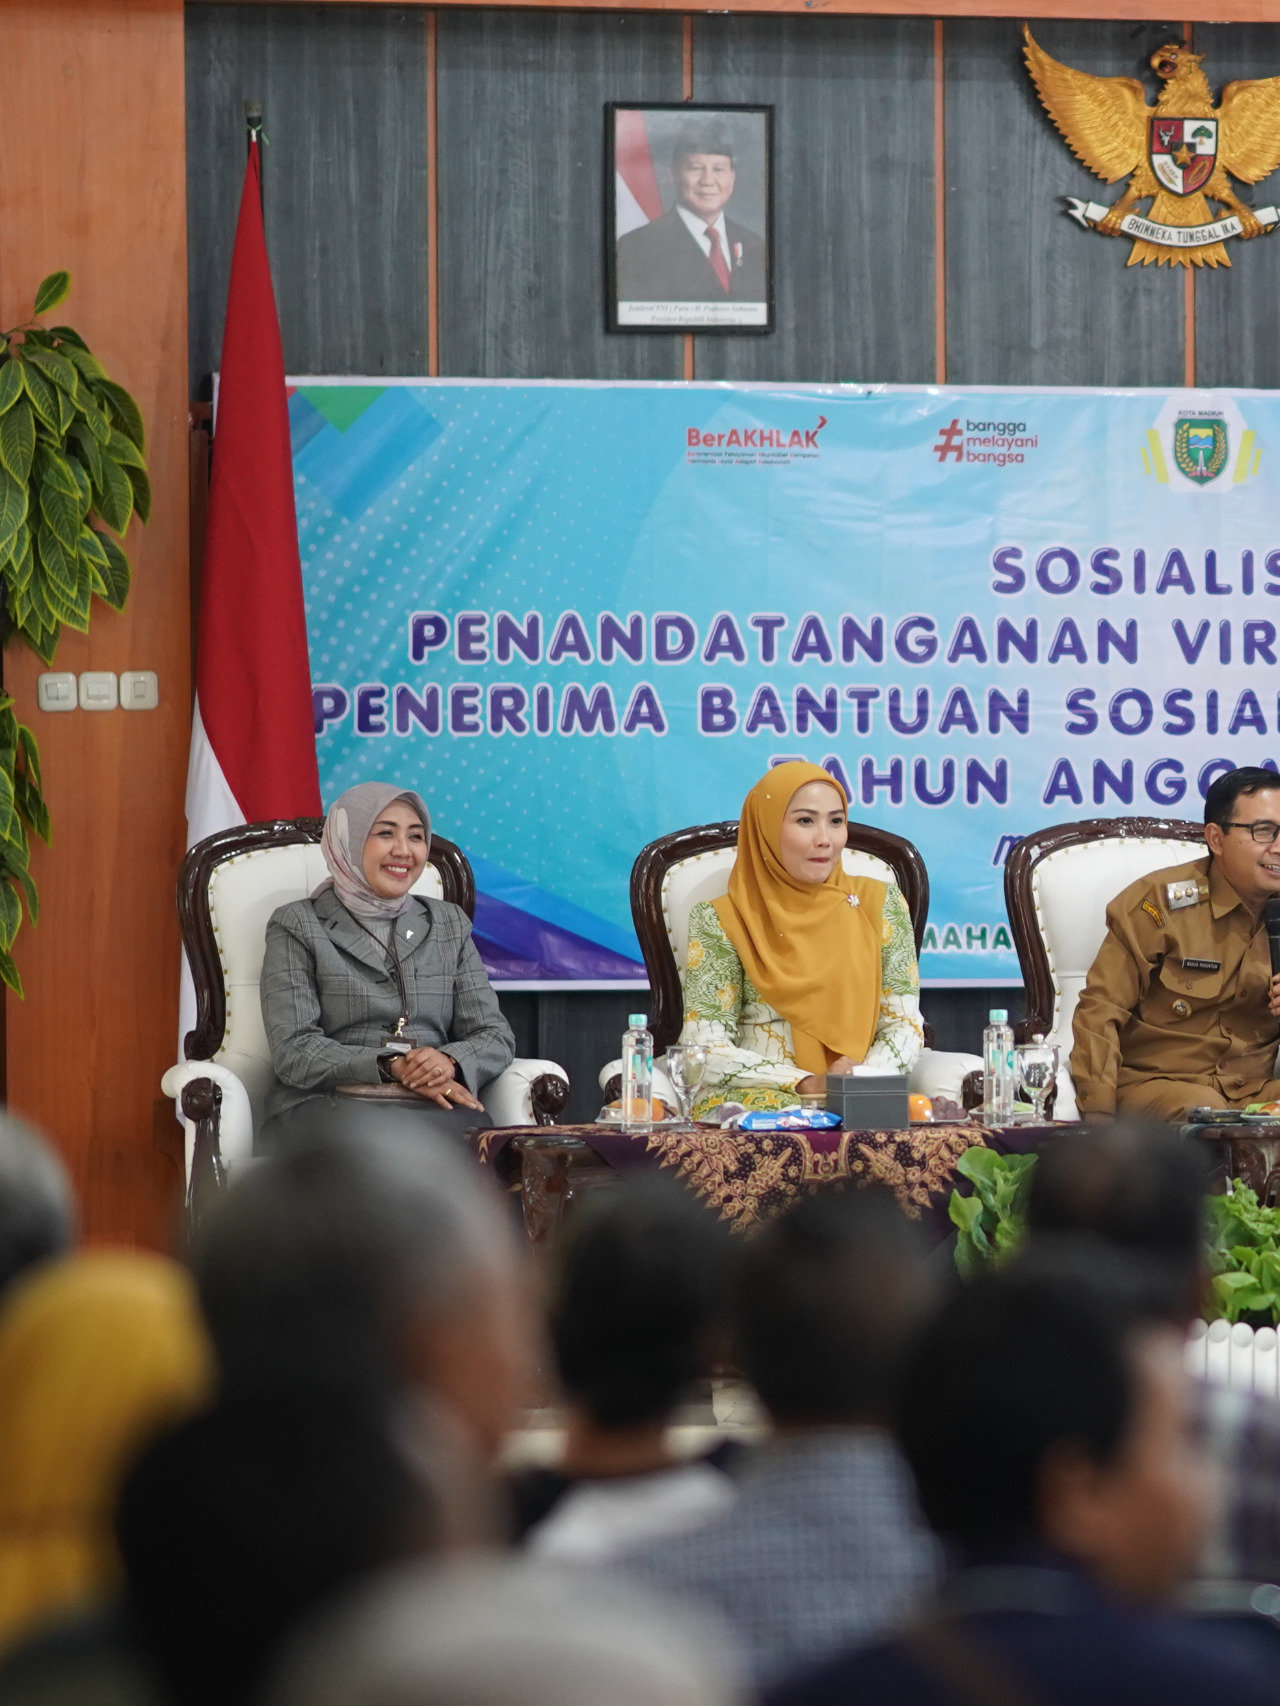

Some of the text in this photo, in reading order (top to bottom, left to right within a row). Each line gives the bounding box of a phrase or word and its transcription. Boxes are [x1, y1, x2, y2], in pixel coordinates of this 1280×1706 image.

[1127, 218, 1237, 243] BHINNEKA TUNGGAL IKA
[687, 427, 818, 448] BerAKHLAK
[967, 420, 1026, 436] bangga
[967, 434, 1038, 451] melayani
[967, 451, 1024, 467] bangsa
[412, 614, 1138, 664] PENANDATANGANAN
[312, 685, 665, 734] PENERIMA
[701, 687, 1029, 735] BANTUAN
[770, 757, 1008, 805] AHUN
